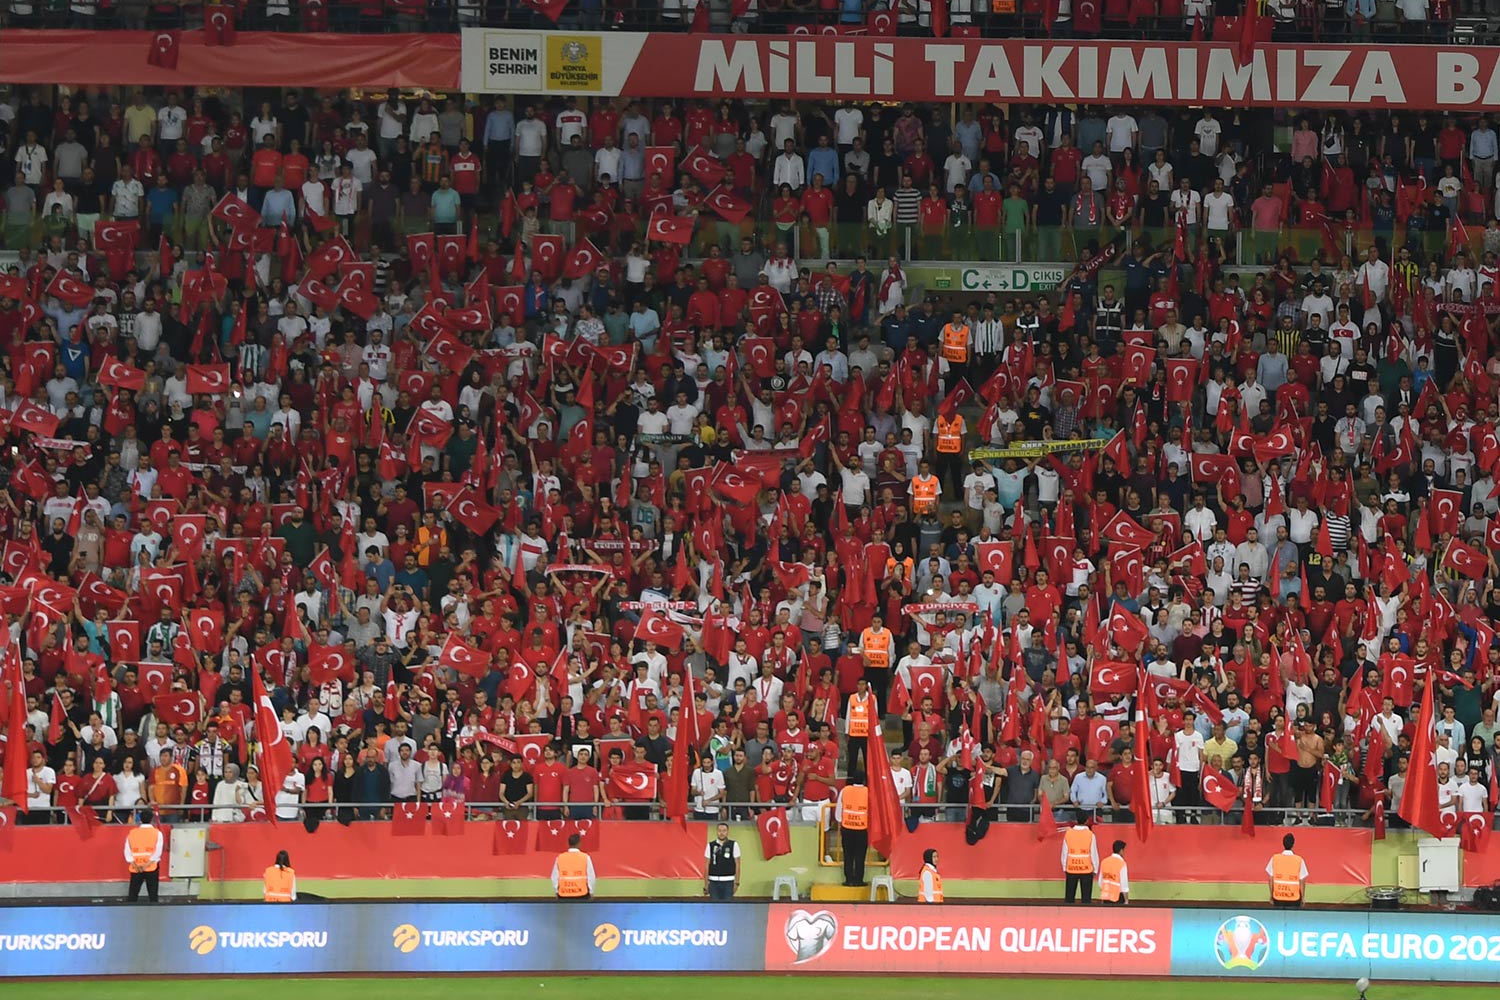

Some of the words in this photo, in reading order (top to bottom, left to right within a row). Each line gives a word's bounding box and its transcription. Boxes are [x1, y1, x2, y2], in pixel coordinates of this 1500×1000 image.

[925, 43, 1407, 103] TAKIMIMIZA
[963, 269, 980, 290] C
[1012, 269, 1029, 290] D
[1033, 270, 1062, 281] ÇIKIŞ
[1039, 283, 1056, 291] EXIT
[1308, 553, 1321, 565] 12
[918, 602, 970, 611] TÜRKİYE
[219, 931, 328, 948] TURKSPORU
[422, 930, 529, 947] TURKSPORU
[622, 929, 728, 947] TURKSPORU
[843, 925, 991, 952] EUROPEAN
[1000, 927, 1157, 954] QUALIFIERS
[1277, 931, 1357, 958] UEFA
[1362, 933, 1445, 960] EURO
